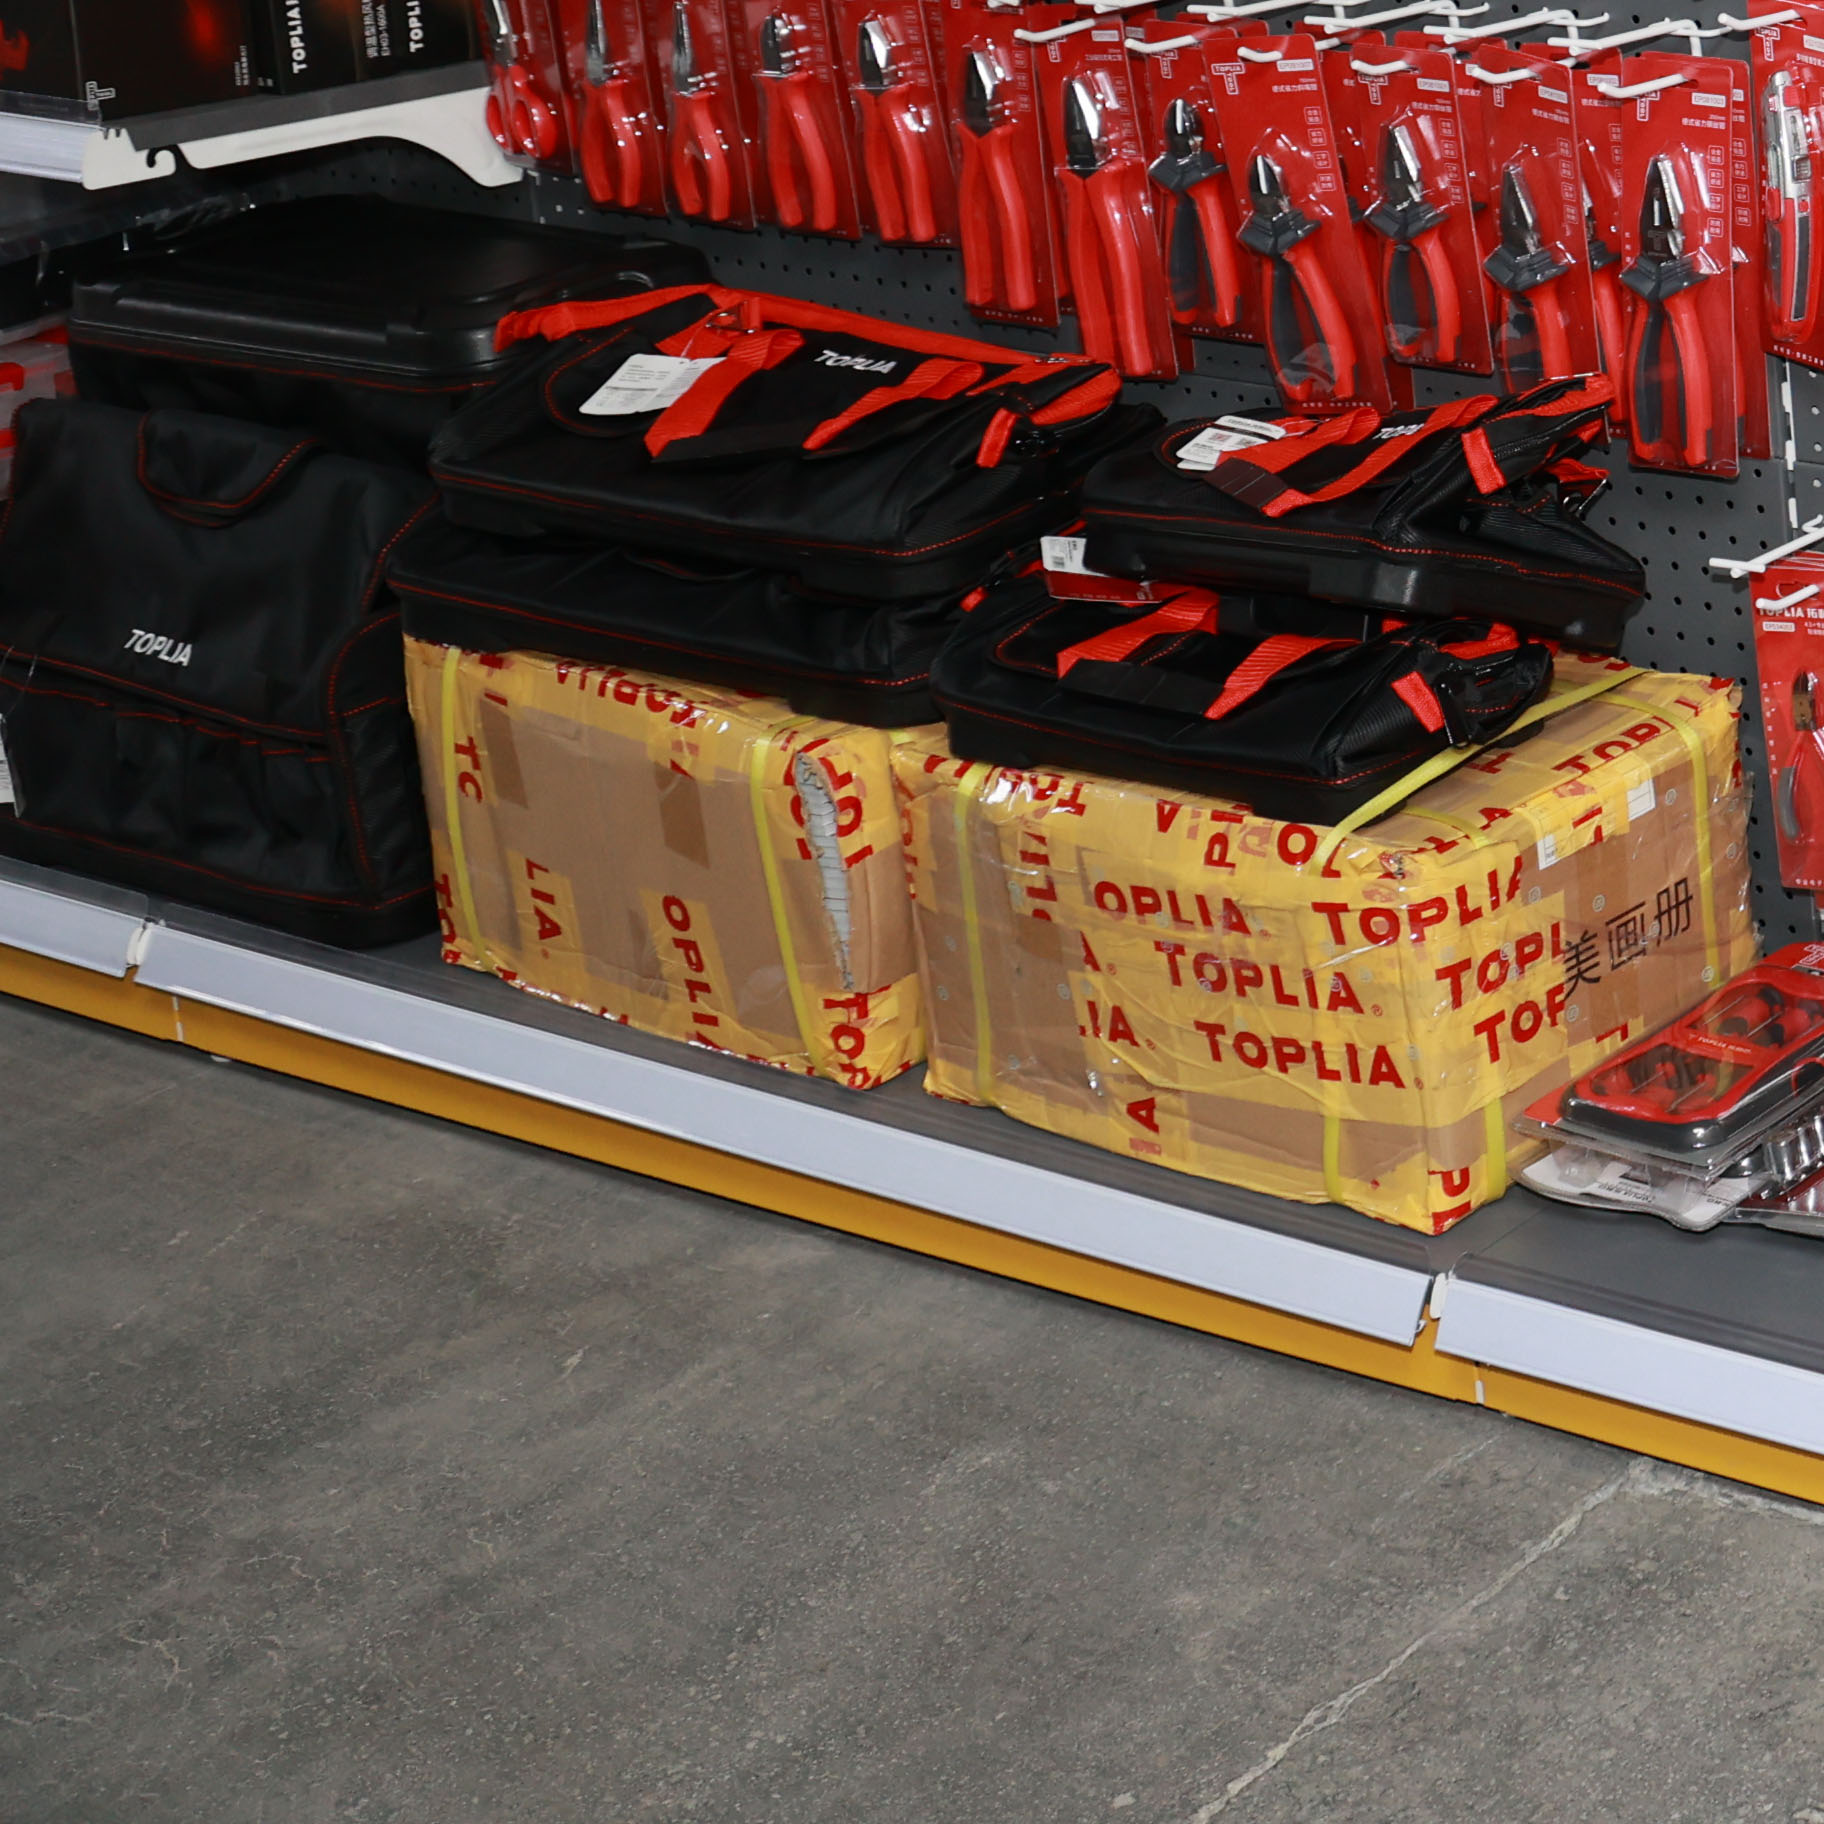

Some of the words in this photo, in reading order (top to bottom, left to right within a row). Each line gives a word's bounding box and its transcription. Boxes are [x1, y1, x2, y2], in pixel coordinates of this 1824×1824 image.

[284, 7, 308, 73] TOPLIA
[814, 349, 899, 375] TOPLIA
[124, 628, 192, 668] TOPLIA
[1312, 855, 1523, 947] TOPLIA
[1562, 876, 1694, 999] 美画册
[1154, 939, 1365, 1015] TOPLIA
[1195, 1019, 1405, 1089] TOPLIA
